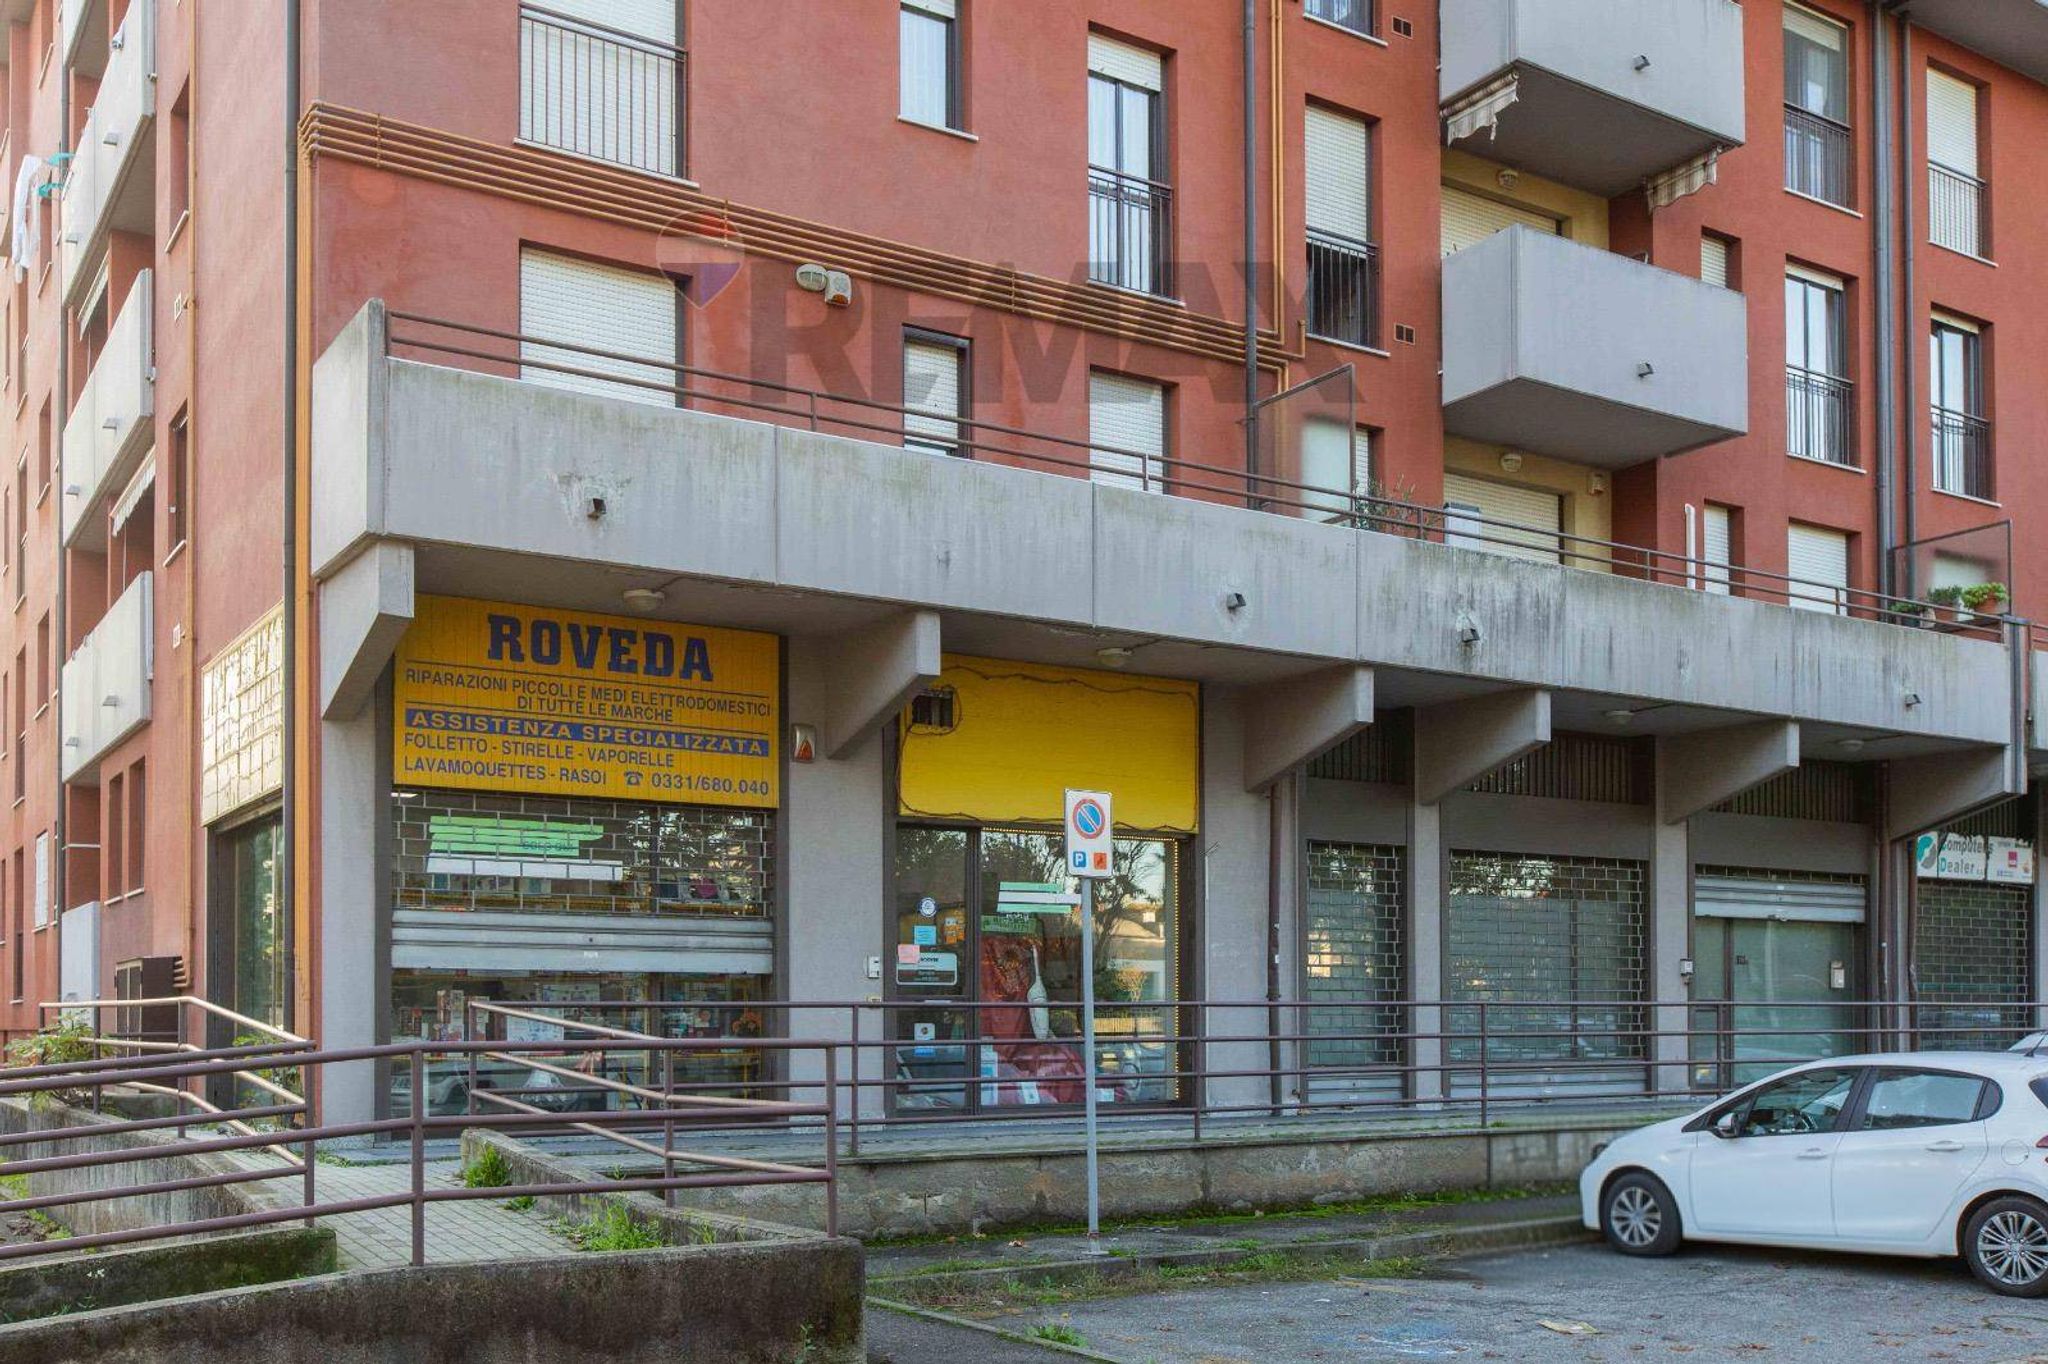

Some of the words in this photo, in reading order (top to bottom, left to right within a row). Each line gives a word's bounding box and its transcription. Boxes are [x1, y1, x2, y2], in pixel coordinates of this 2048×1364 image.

[487, 612, 714, 682] ROVEDA
[405, 668, 507, 692] RIPARAZIONI
[512, 678, 573, 698] PICCOLI
[577, 684, 587, 699] E
[591, 686, 626, 702] MEDI
[631, 690, 771, 717] ELETTRODOMESTICI
[517, 695, 533, 710] DI
[537, 697, 583, 714] TUTTE
[588, 702, 607, 717] LE
[611, 703, 674, 723] MARCHE
[404, 732, 488, 753] FOLLETTO
[502, 740, 574, 760] STIRELLE
[587, 747, 675, 768] VAPORELLE
[411, 711, 572, 739] ASSISTENZA
[582, 725, 763, 756] SPECIALIZZATA
[404, 755, 546, 780] LAVAMOQUETTES
[560, 768, 607, 785] RASOI
[651, 772, 769, 796] 0331/680.040
[1075, 853, 1083, 866] P
[1940, 857, 1975, 874] Dealer
